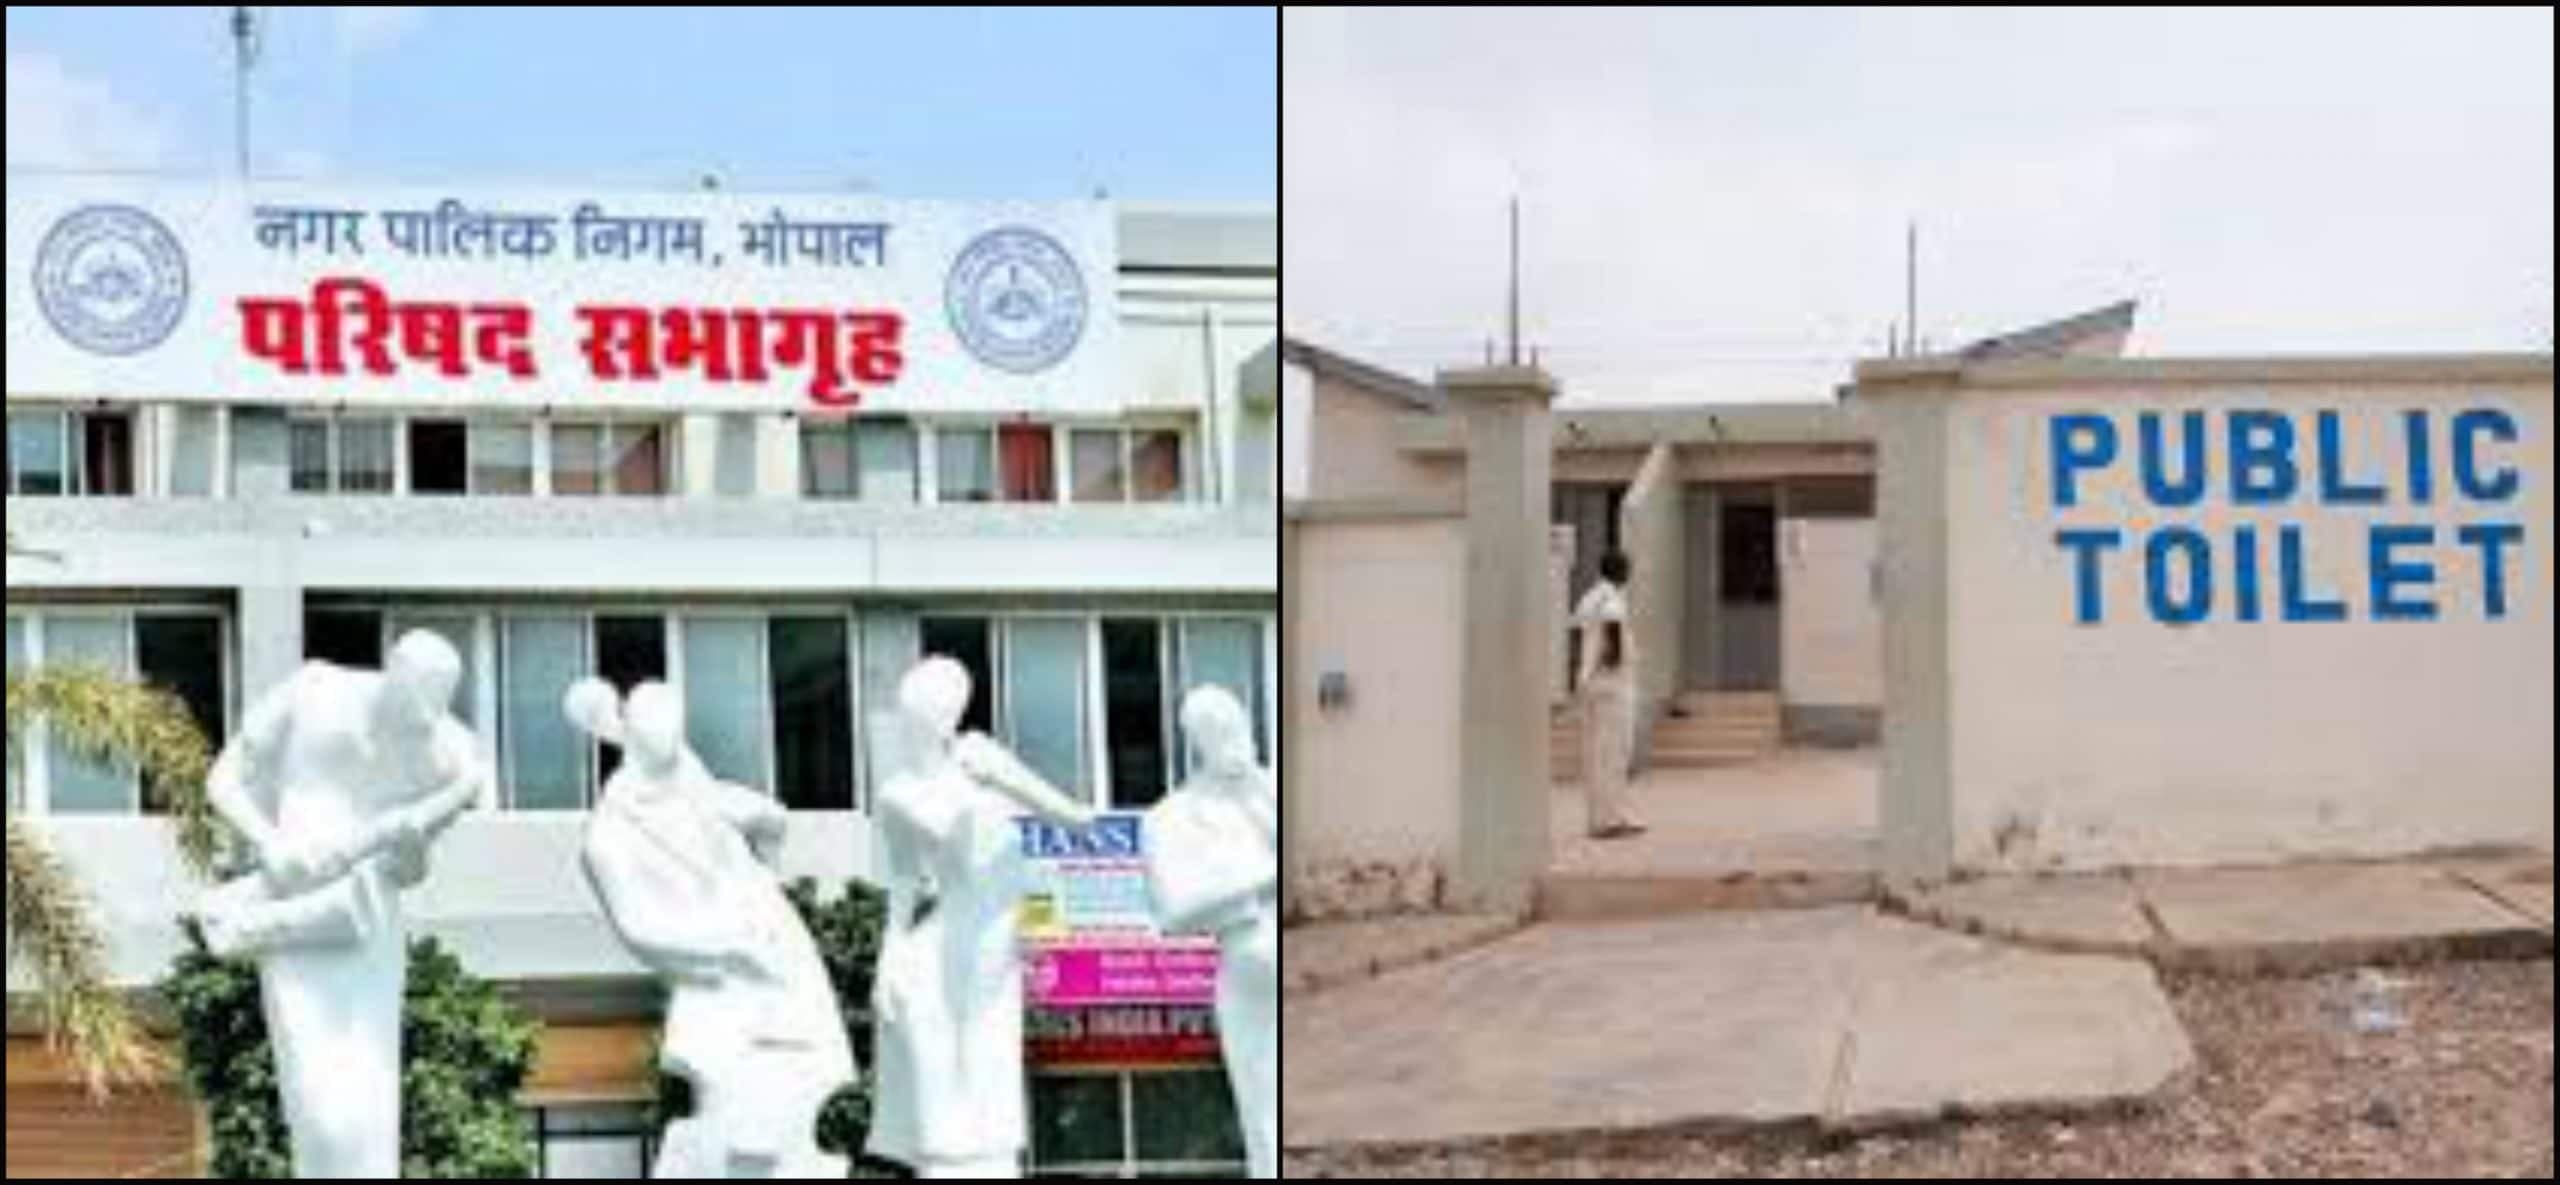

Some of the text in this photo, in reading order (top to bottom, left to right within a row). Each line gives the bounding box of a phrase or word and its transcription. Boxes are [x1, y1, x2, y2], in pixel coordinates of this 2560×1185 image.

[253, 205, 367, 256] नगर
[380, 198, 558, 261] पालिक
[738, 206, 893, 268] भोपाल
[239, 276, 538, 380] परिषद
[573, 300, 905, 410] सभागृह
[2049, 409, 2519, 507] PUBLIC
[2053, 523, 2525, 626] TOILET
